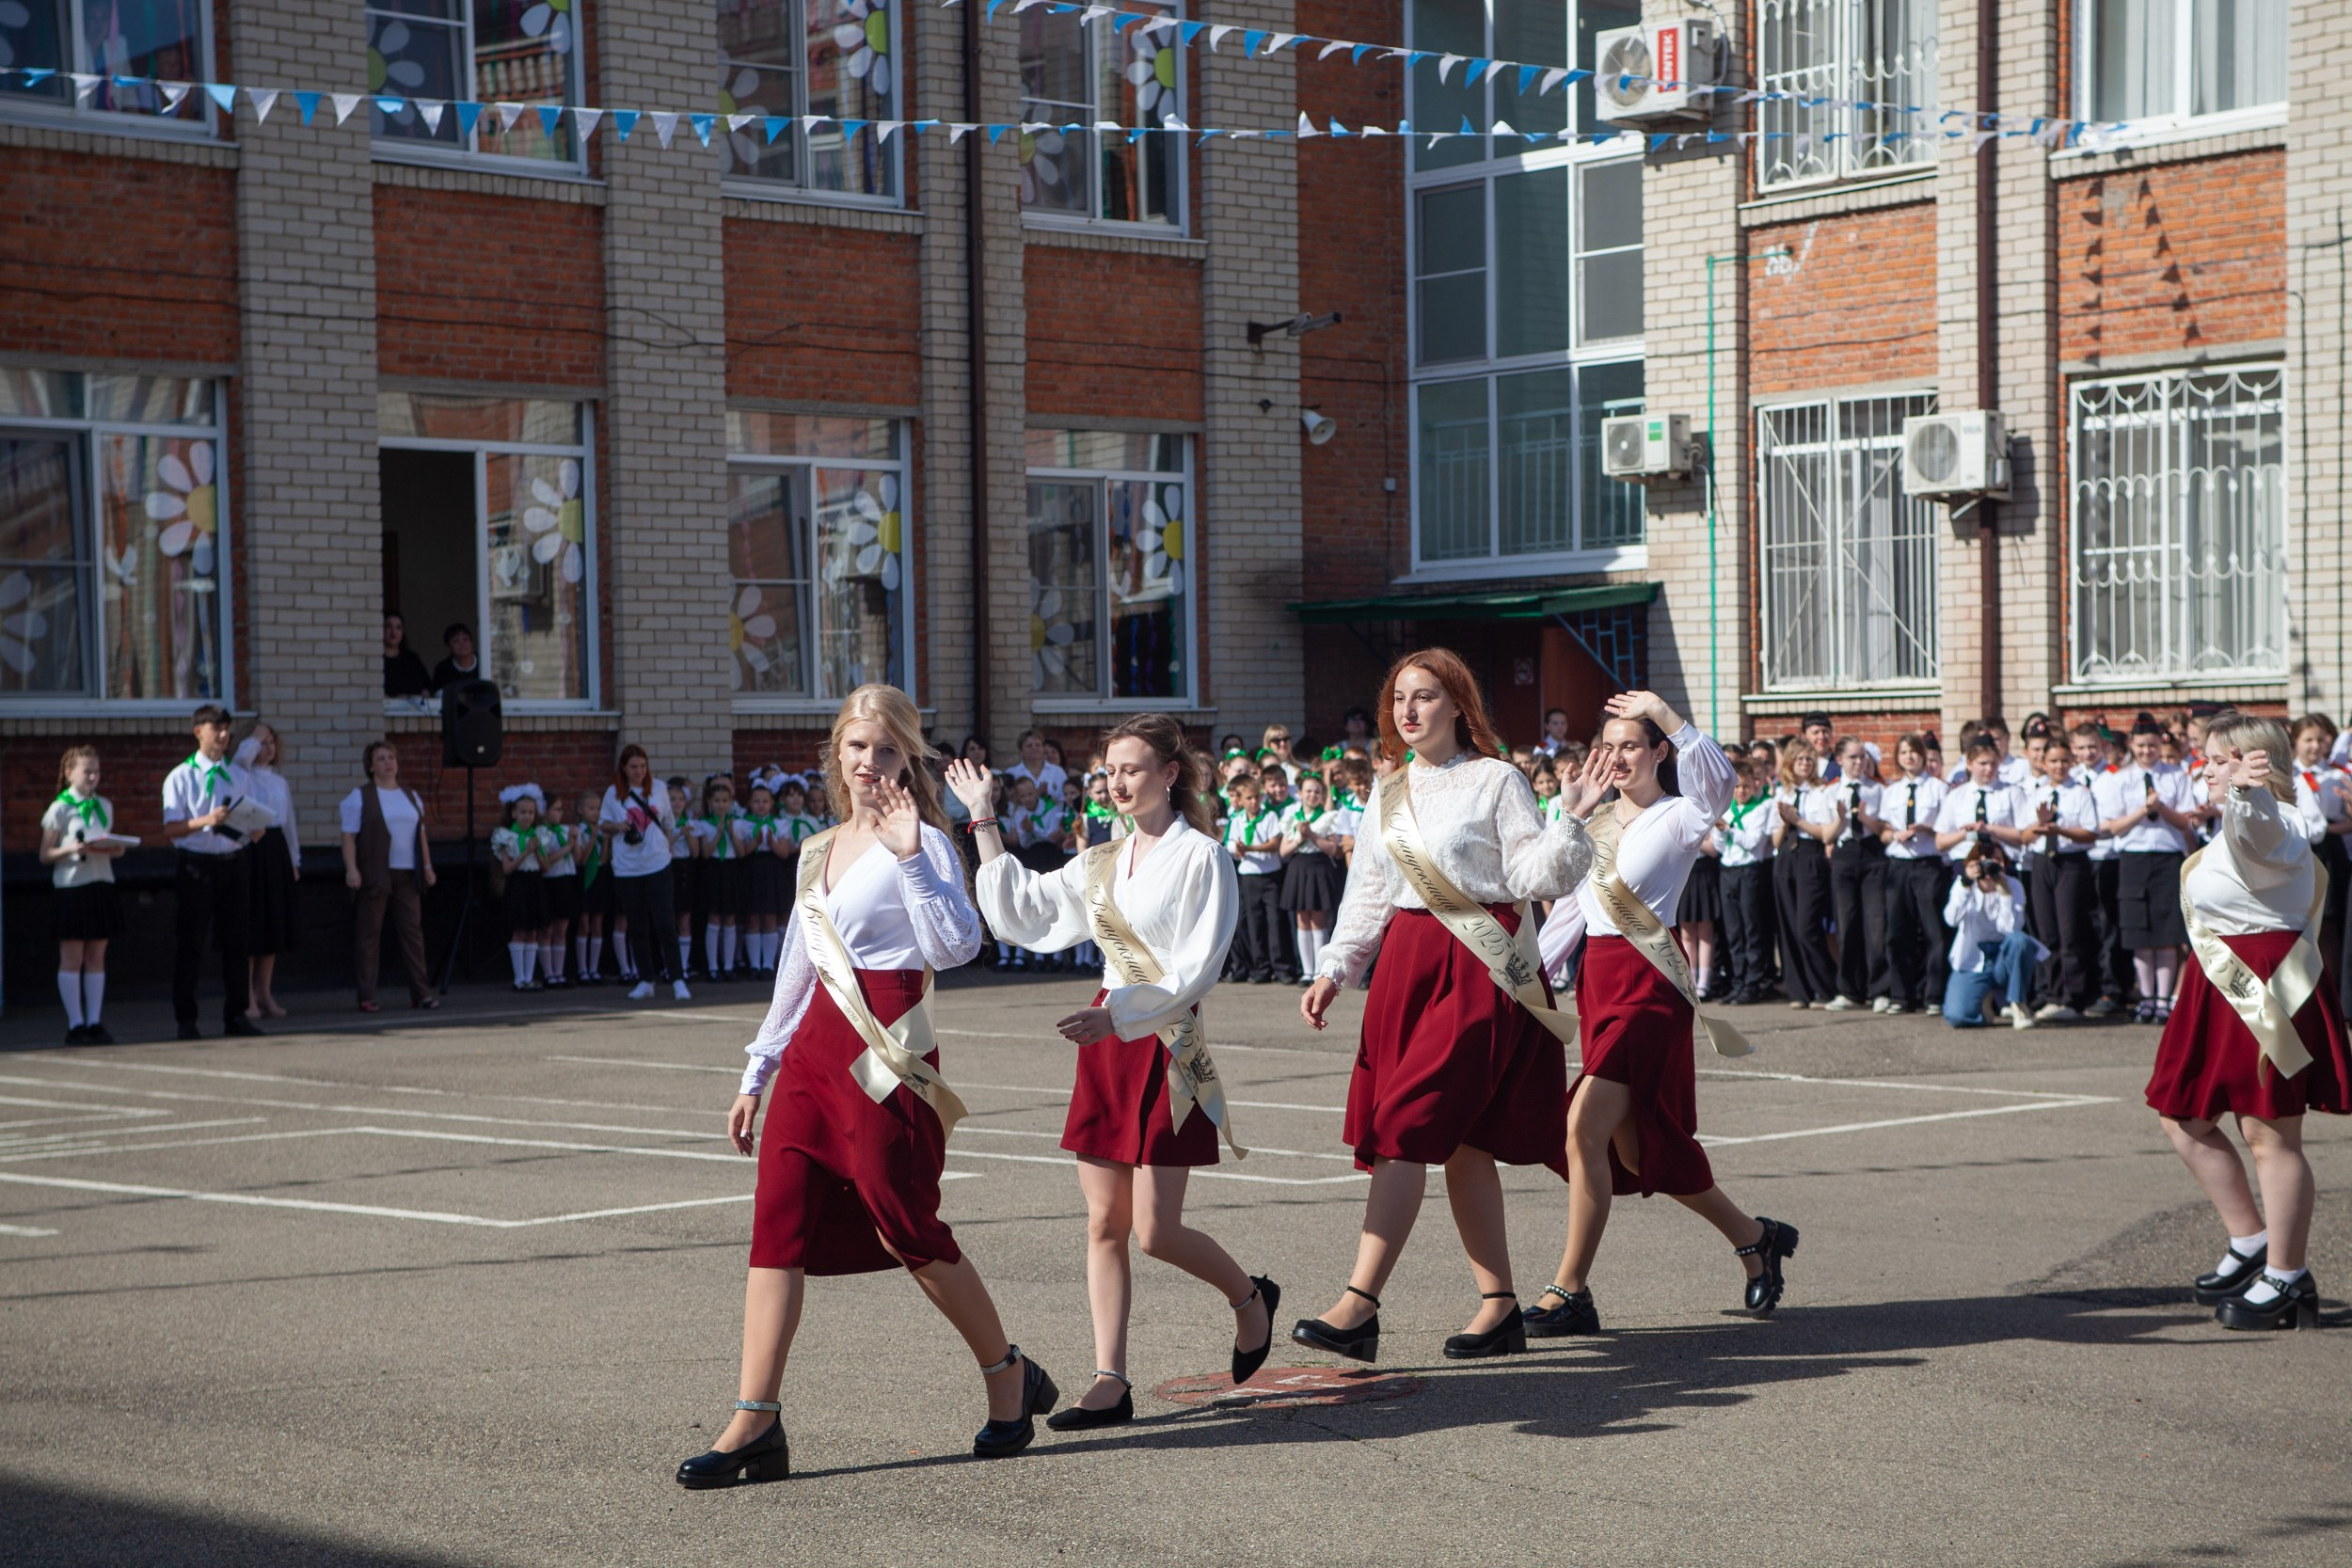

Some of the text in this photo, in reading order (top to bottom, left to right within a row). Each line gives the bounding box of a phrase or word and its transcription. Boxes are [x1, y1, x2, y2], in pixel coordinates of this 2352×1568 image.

[1662, 33, 1674, 90] ENTEK
[1091, 885, 1151, 985] Выпускниц
[1463, 915, 1511, 956] 2025
[1592, 841, 1648, 933] Выпускница
[1649, 936, 1687, 977] 2025
